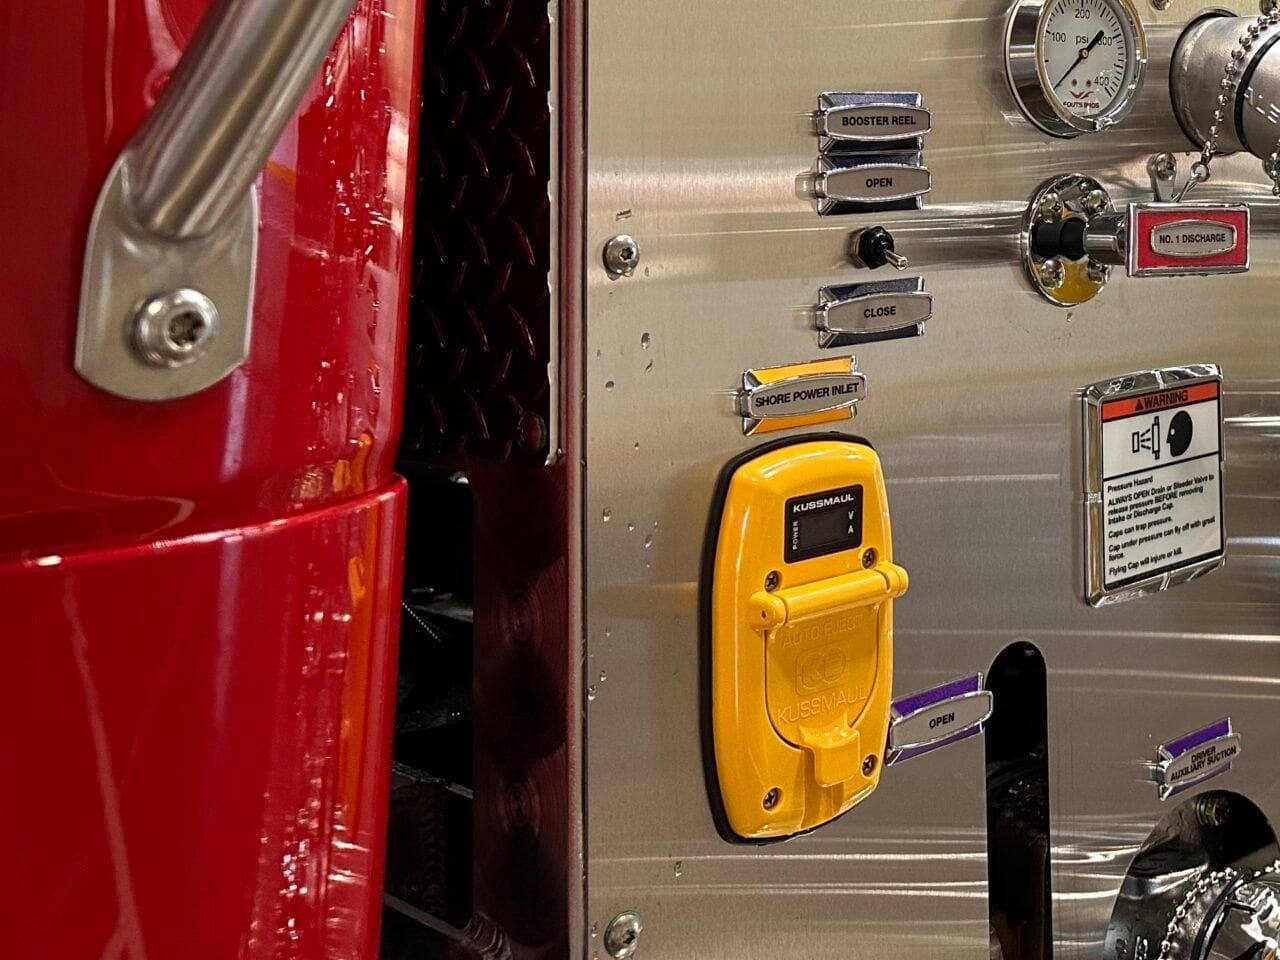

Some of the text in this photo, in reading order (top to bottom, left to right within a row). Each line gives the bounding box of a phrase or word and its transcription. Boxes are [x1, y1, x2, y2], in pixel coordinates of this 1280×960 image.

[1074, 8, 1090, 19] 200
[1051, 32, 1066, 42] 100
[1075, 35, 1089, 45] psi
[1097, 36, 1112, 46] 300
[1094, 76, 1109, 87] 400
[841, 116, 916, 126] BOOSTER REEL
[865, 178, 893, 188] OPEN
[1159, 235, 1173, 243] NO.
[1182, 233, 1226, 243] DISCHARGE
[863, 306, 896, 318] CLOSE
[755, 382, 860, 407] SHORE POWER INLET
[1143, 390, 1189, 409] WARNING
[1108, 476, 1153, 492] Pressure Hazard
[1108, 494, 1132, 506] ALWAYS
[1134, 490, 1149, 500] OPEN
[1151, 486, 1165, 494] Drain
[1173, 480, 1193, 489] Bleeder
[1194, 476, 1208, 484] Valve
[793, 493, 854, 513] KUSSMAUL
[1108, 486, 1203, 515] release pressure BEFORE removing
[848, 511, 854, 520] V
[1108, 515, 1125, 524] Intake
[1134, 506, 1161, 518] Discharge
[848, 525, 854, 534] A
[1109, 529, 1123, 538] Caps
[1136, 522, 1146, 530] trap
[1148, 516, 1172, 527] pressure.
[1109, 544, 1120, 552] Cap
[1122, 539, 1137, 548] under
[1139, 532, 1162, 545] pressure
[1191, 520, 1200, 528] with
[1202, 516, 1215, 527] great
[1110, 565, 1126, 576] Flying
[1128, 562, 1139, 570] Cap
[1140, 557, 1149, 565] will
[1151, 554, 1165, 563] injure
[1174, 547, 1182, 555] kill.
[783, 614, 863, 648] AUTO EJECT
[778, 686, 868, 725] KUSSMAUL
[929, 712, 955, 728] OPEN
[1191, 746, 1216, 763] DRIVER
[1170, 745, 1236, 781] AUXILIARY SUCTION
